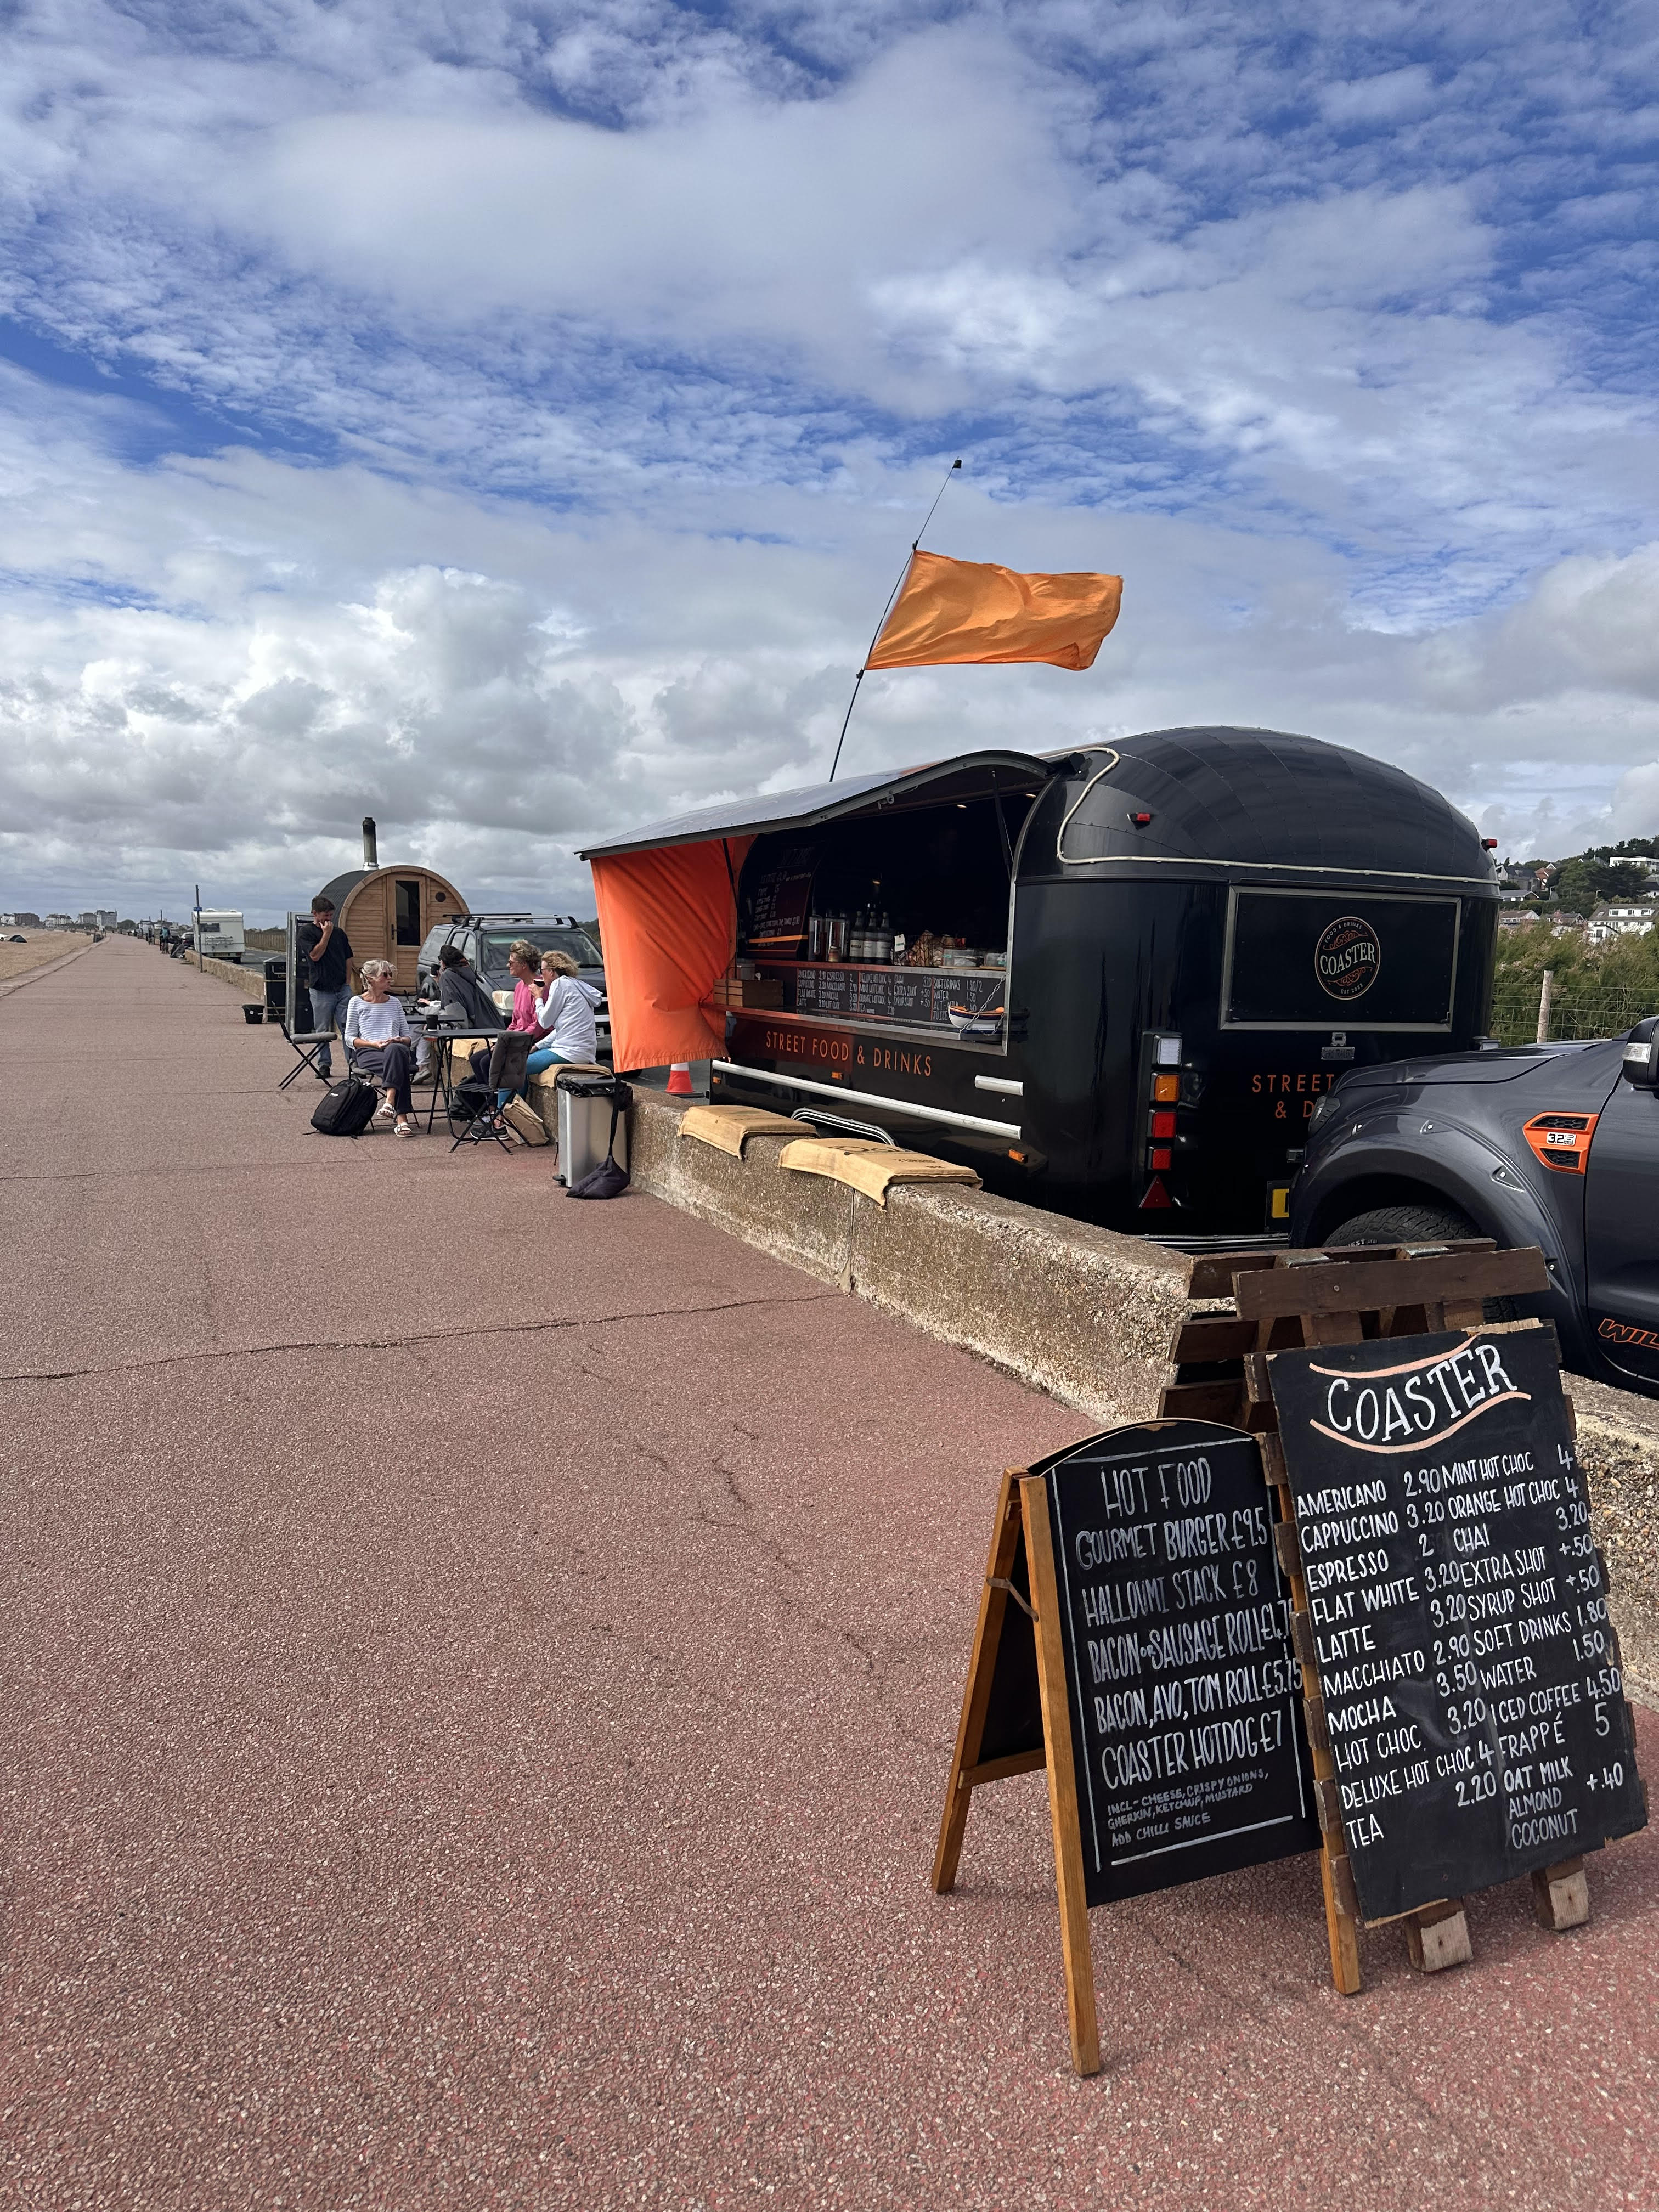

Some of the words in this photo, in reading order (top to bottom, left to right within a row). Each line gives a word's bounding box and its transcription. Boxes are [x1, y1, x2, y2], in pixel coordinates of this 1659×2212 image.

[1320, 943, 1376, 975] COASTER
[1324, 928, 1336, 943] FOOD
[934, 978, 943, 989] SOFT
[944, 979, 960, 991] DRINKS
[934, 990, 949, 1001] WATER
[766, 1031, 805, 1054] STREET
[812, 1038, 848, 1062] FOOD
[857, 1046, 865, 1065] &
[874, 1048, 931, 1077] DRINKS
[1252, 1074, 1334, 1092] STREET
[1275, 1101, 1286, 1118] &
[1328, 1344, 1517, 1443] COASTER
[1101, 1466, 1148, 1519] HOT
[1158, 1457, 1211, 1509] FOOD
[1297, 1480, 1387, 1518] AMERICANO
[1404, 1469, 1441, 1498] 2.90
[1442, 1459, 1477, 1491] MINT
[1480, 1454, 1498, 1480] HOT
[1503, 1451, 1534, 1474] CHOC
[1558, 1444, 1573, 1469] 4
[1448, 1489, 1501, 1520] ORANGE
[1505, 1484, 1525, 1509] HOT
[1528, 1478, 1560, 1503] CHOC
[1567, 1476, 1579, 1498] 4
[1076, 1521, 1157, 1570] GOURMET
[1164, 1513, 1229, 1561] BURGER
[1301, 1512, 1399, 1553] CAPPUCCINO
[1407, 1502, 1444, 1529] 3.20
[1453, 1523, 1490, 1552] CHAI
[1555, 1503, 1588, 1531] 3.20
[1306, 1549, 1389, 1592] ESPRESSO
[1418, 1533, 1434, 1557] 2
[1461, 1559, 1513, 1589] EXTRA
[1516, 1545, 1548, 1577] SHOT
[1559, 1533, 1594, 1558] +.50
[1082, 1576, 1170, 1628] HALLOUMI
[1172, 1564, 1227, 1610] STACK
[1233, 1559, 1259, 1599] £8
[1312, 1593, 1356, 1626] FLAT
[1362, 1577, 1419, 1612] WHITE
[1425, 1561, 1459, 1592] 3.20
[1469, 1589, 1514, 1621] SYRUP
[1520, 1578, 1556, 1609] SHOT
[1565, 1565, 1600, 1594] +.50
[1087, 1632, 1142, 1684] BACON
[1150, 1615, 1226, 1670] SAUSAGE
[1225, 1607, 1265, 1656] ROLL
[1316, 1624, 1376, 1664] LATTE
[1430, 1595, 1467, 1628] 3.20
[1474, 1623, 1513, 1656] SOFT
[1519, 1612, 1571, 1646] DRINKS
[1576, 1598, 1607, 1627] 1.80
[1226, 1665, 1262, 1707] ROLL
[1262, 1657, 1303, 1699] £5.75
[1324, 1650, 1425, 1699] MACCHIATO
[1434, 1634, 1469, 1666] 2.90
[1480, 1656, 1536, 1690] WATER
[1573, 1630, 1605, 1661] 1.50
[1328, 1697, 1396, 1735] MOCHA
[1437, 1662, 1477, 1699] 3.50
[1490, 1696, 1525, 1728] ICED
[1528, 1683, 1581, 1716] COFFEE
[1587, 1668, 1621, 1700] 4.50
[1102, 1732, 1188, 1790] COASTER
[1190, 1716, 1258, 1770] HOTDOG
[1260, 1710, 1282, 1752] £7
[1334, 1741, 1372, 1773] HOT
[1447, 1698, 1485, 1735] 3.20
[1500, 1711, 1565, 1758] FRAPPÉ
[1595, 1702, 1610, 1737] 5
[1187, 1777, 1224, 1797] CRISPY
[1205, 1783, 1253, 1803] MUSTARD
[1341, 1778, 1402, 1810] DELUXE
[1404, 1760, 1430, 1790] HOT
[1436, 1746, 1474, 1778] CHOC
[1479, 1741, 1495, 1765] 4
[1504, 1764, 1532, 1792] OAT
[1539, 1756, 1573, 1787] MILK
[1587, 1762, 1623, 1791] +.40
[1112, 1831, 1132, 1847] ADD
[1136, 1823, 1169, 1840] CHILLI
[1175, 1812, 1211, 1830] SAUCE
[1346, 1814, 1384, 1848] TEA
[1455, 1771, 1497, 1807] 2.20
[1509, 1787, 1562, 1819] ALMOND
[1512, 1809, 1579, 1849] COCONUT
